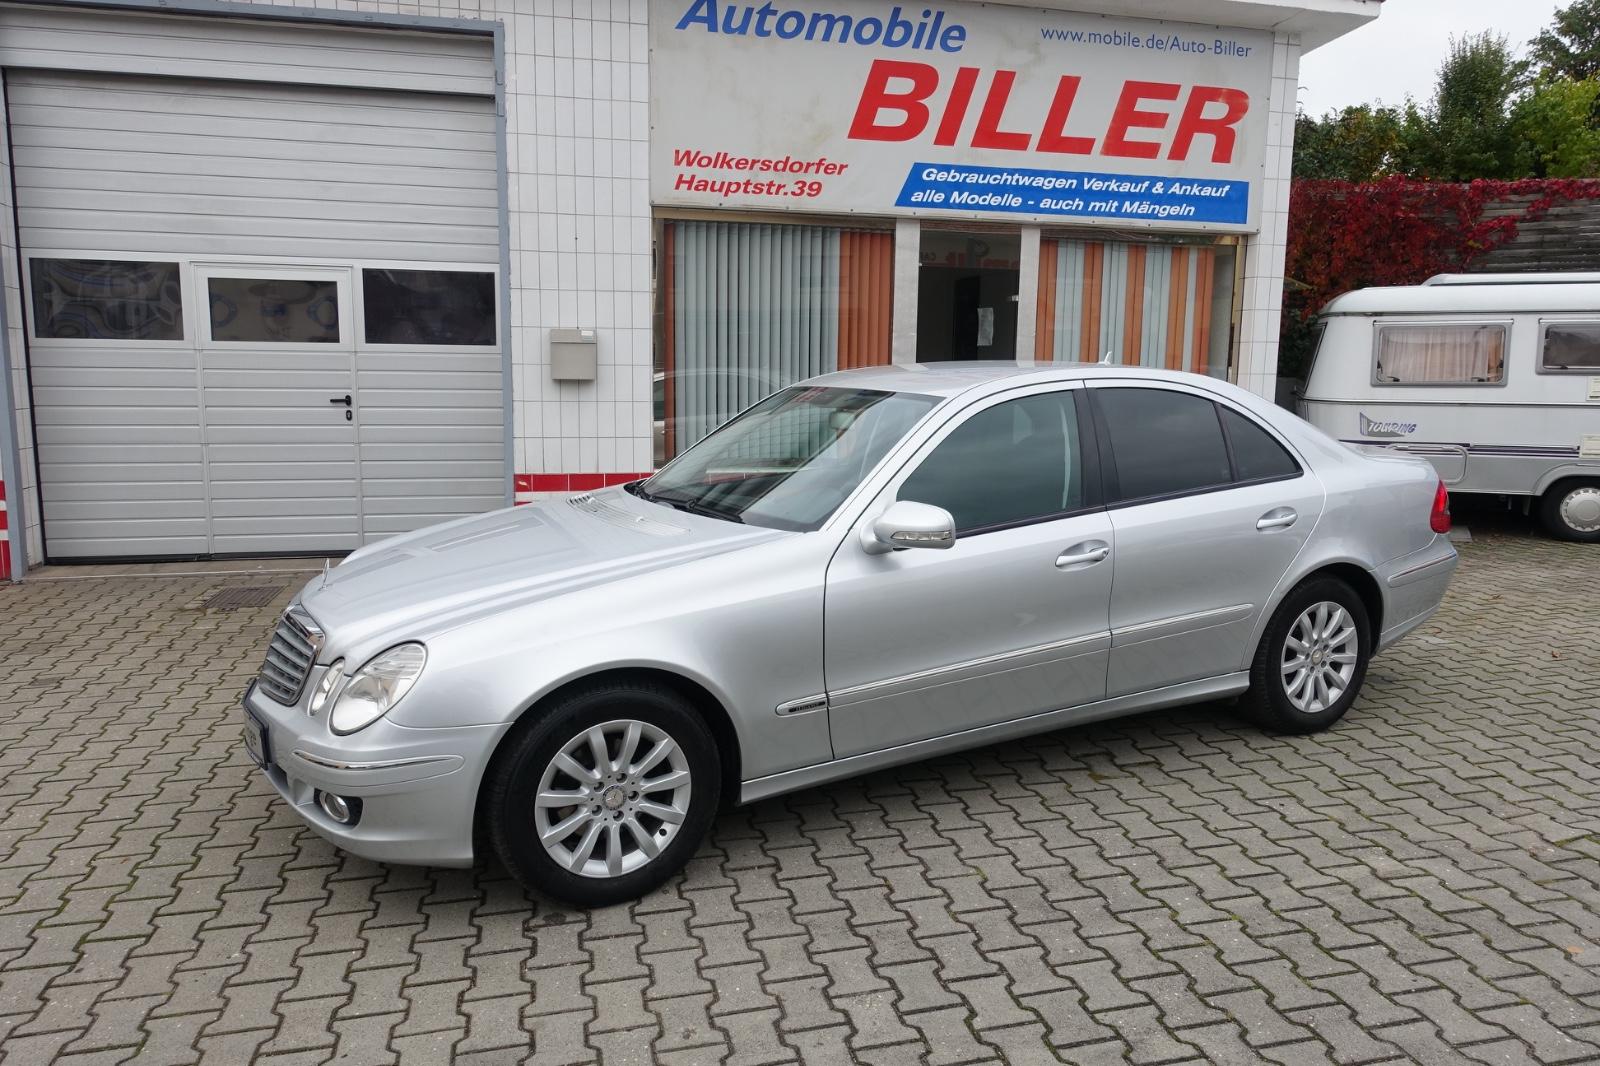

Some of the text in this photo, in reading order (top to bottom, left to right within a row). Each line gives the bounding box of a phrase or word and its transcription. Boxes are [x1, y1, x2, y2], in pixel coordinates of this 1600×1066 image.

[675, 0, 968, 53] Automobile
[1040, 26, 1252, 58] www.mobile.de/Auto-Biller
[848, 59, 1248, 163] BILLER
[673, 149, 848, 176] Wolkersdorfer
[674, 174, 823, 198] Hauptstr.39
[921, 168, 1231, 198] Gebrauchtwagen Verkauf & Ankauf
[910, 189, 945, 204] alle
[949, 190, 1023, 207] Modelle
[1039, 198, 1084, 211] auch
[1087, 199, 1119, 213] mit
[1121, 200, 1196, 218] Mängeln
[1368, 422, 1417, 434] TOURING
